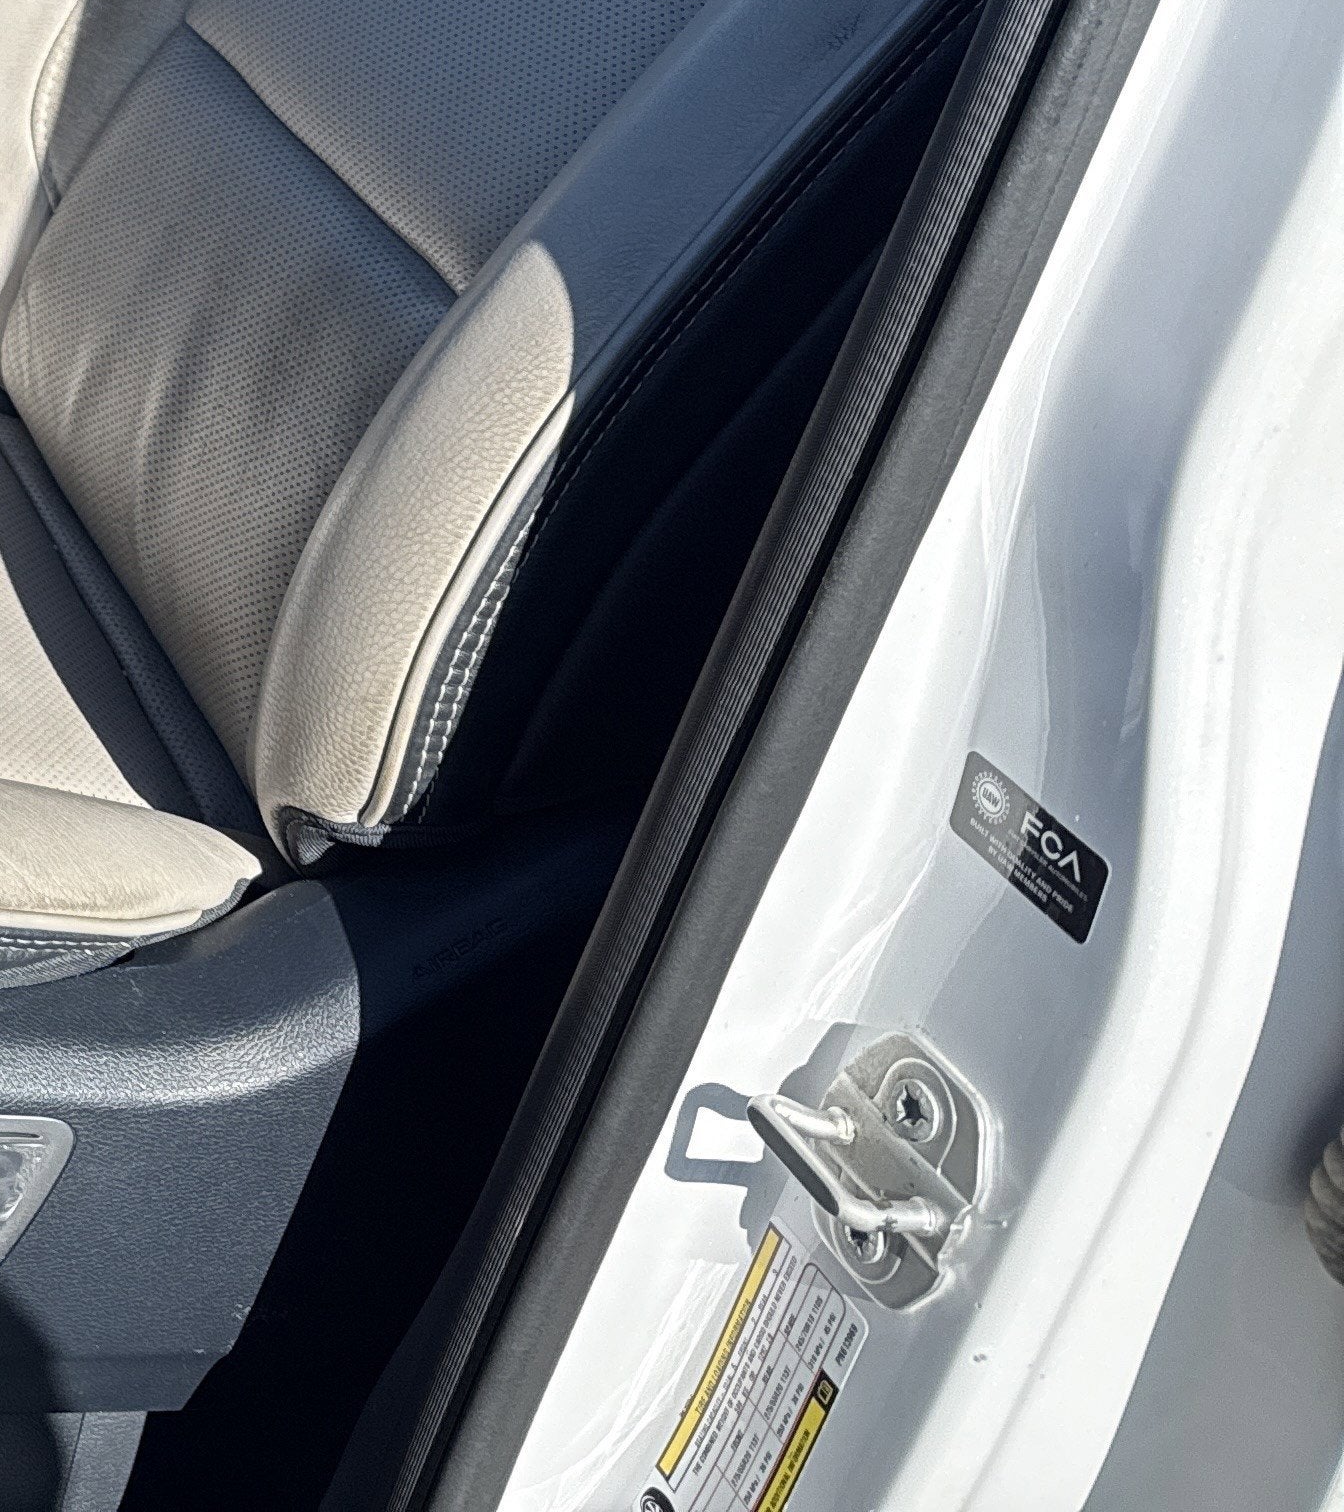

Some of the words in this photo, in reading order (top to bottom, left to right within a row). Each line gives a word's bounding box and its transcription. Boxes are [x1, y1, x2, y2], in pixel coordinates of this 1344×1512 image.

[982, 787, 1000, 809] UAW
[970, 818, 989, 838] BUILT
[1036, 875, 1052, 894] AND
[1052, 890, 1074, 914] PRIDE
[1020, 811, 1081, 883] FCA
